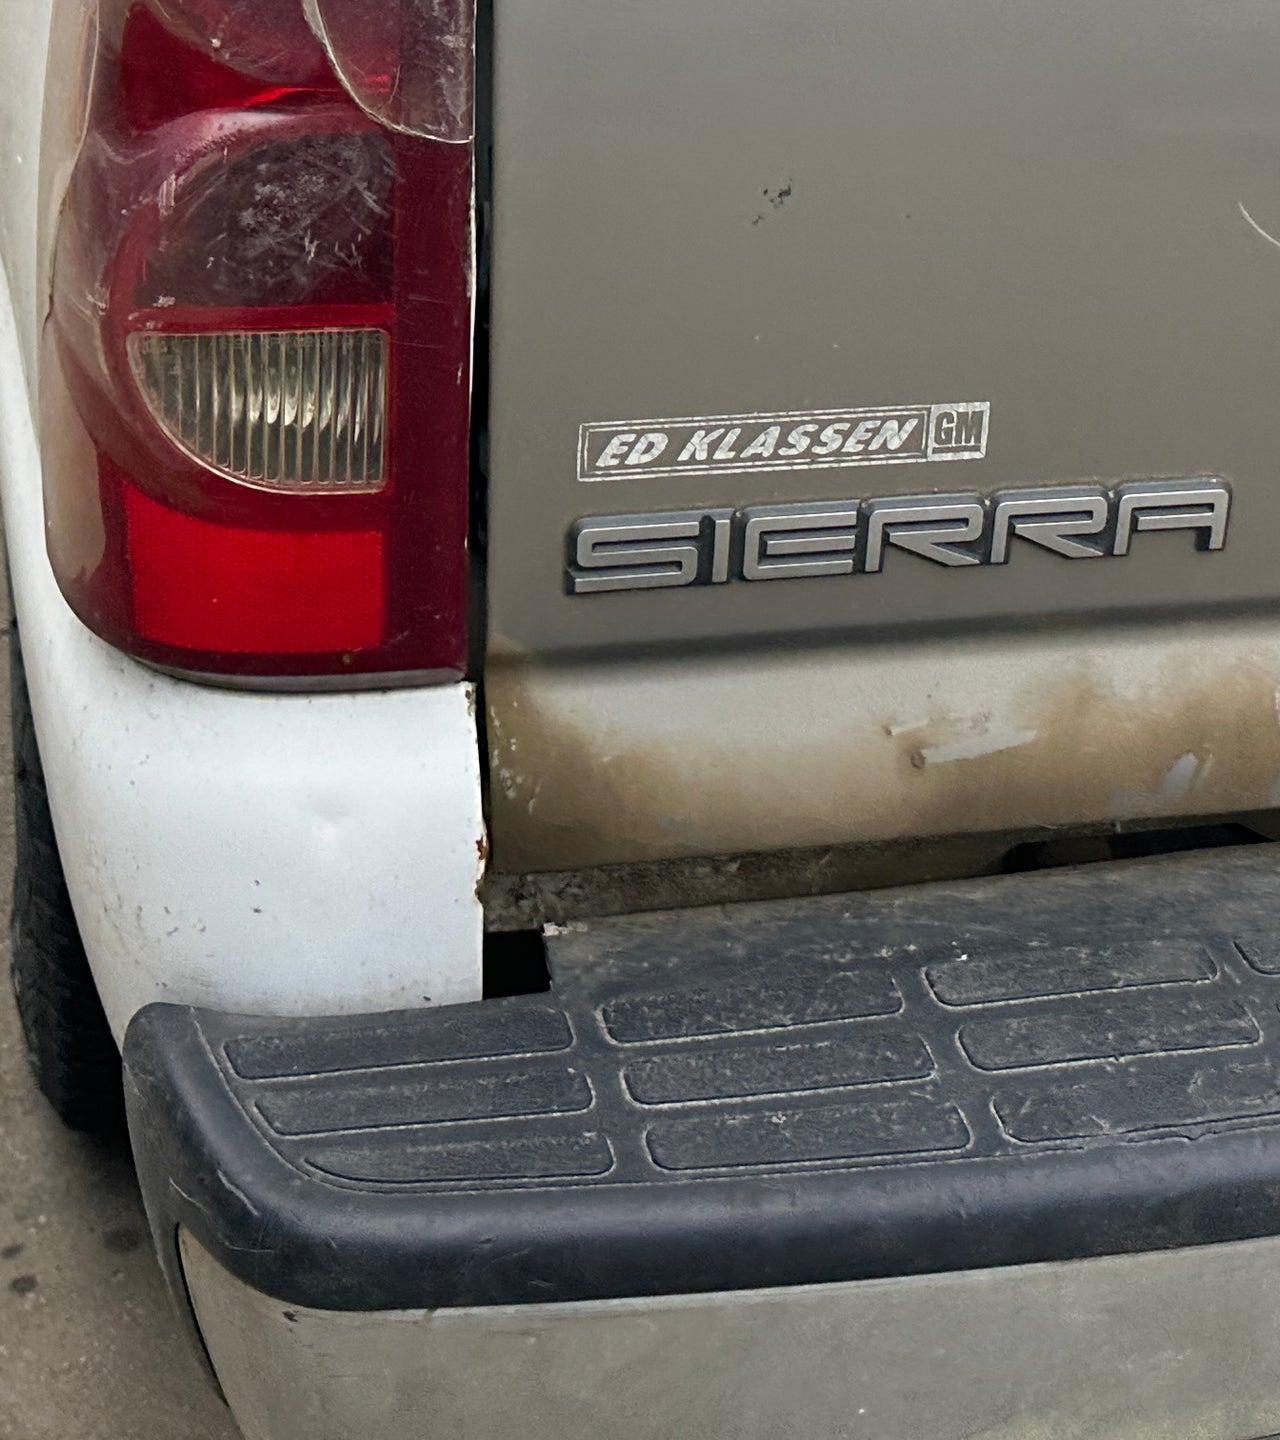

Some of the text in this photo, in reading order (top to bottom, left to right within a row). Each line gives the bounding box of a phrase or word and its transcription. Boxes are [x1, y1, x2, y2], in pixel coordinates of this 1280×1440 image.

[595, 409, 985, 468] ED KLASSEN GM
[566, 477, 1233, 594] SIERRA
